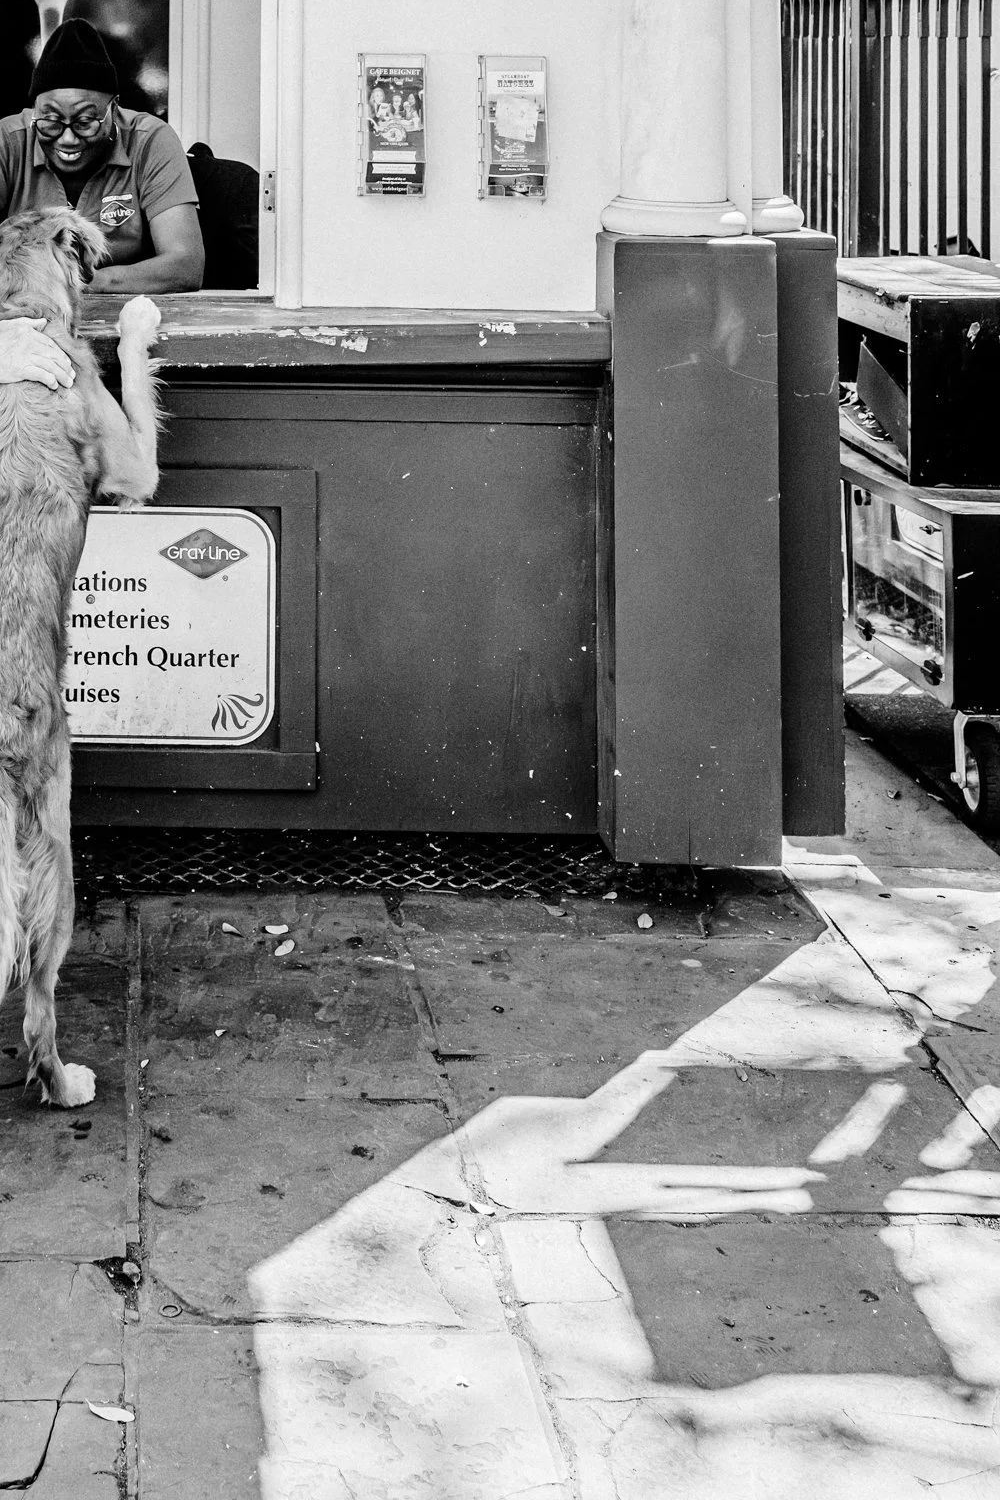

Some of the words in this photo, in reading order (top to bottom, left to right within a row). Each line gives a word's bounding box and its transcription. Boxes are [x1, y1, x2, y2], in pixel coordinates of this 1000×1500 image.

[167, 545, 208, 560] Gray
[208, 546, 241, 561] Line
[65, 608, 170, 630] meteries
[69, 644, 138, 666] rench
[146, 646, 240, 672] Quarter
